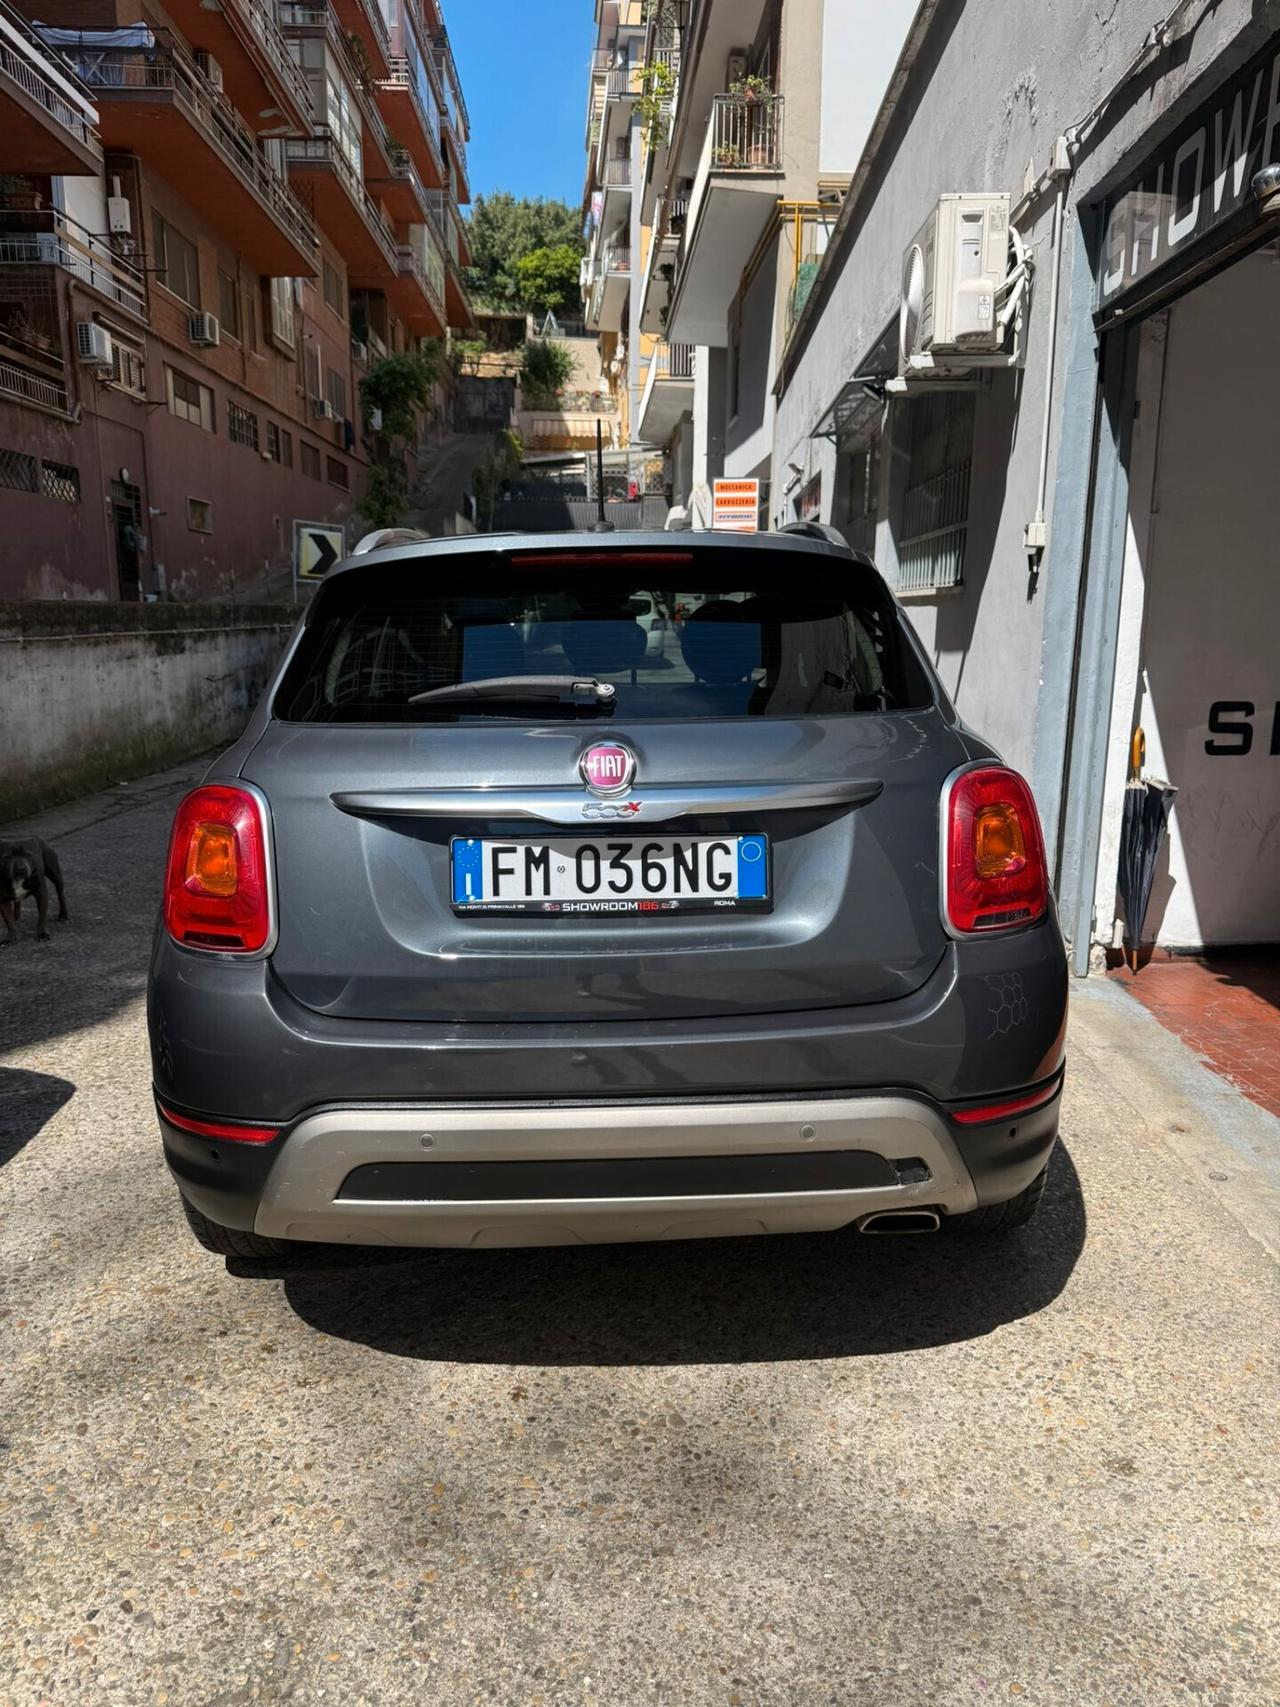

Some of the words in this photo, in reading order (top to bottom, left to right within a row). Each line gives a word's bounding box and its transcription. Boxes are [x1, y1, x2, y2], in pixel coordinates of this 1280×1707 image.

[592, 754, 624, 778] FIAT
[491, 845, 550, 897] FM
[575, 841, 733, 895] 036NG
